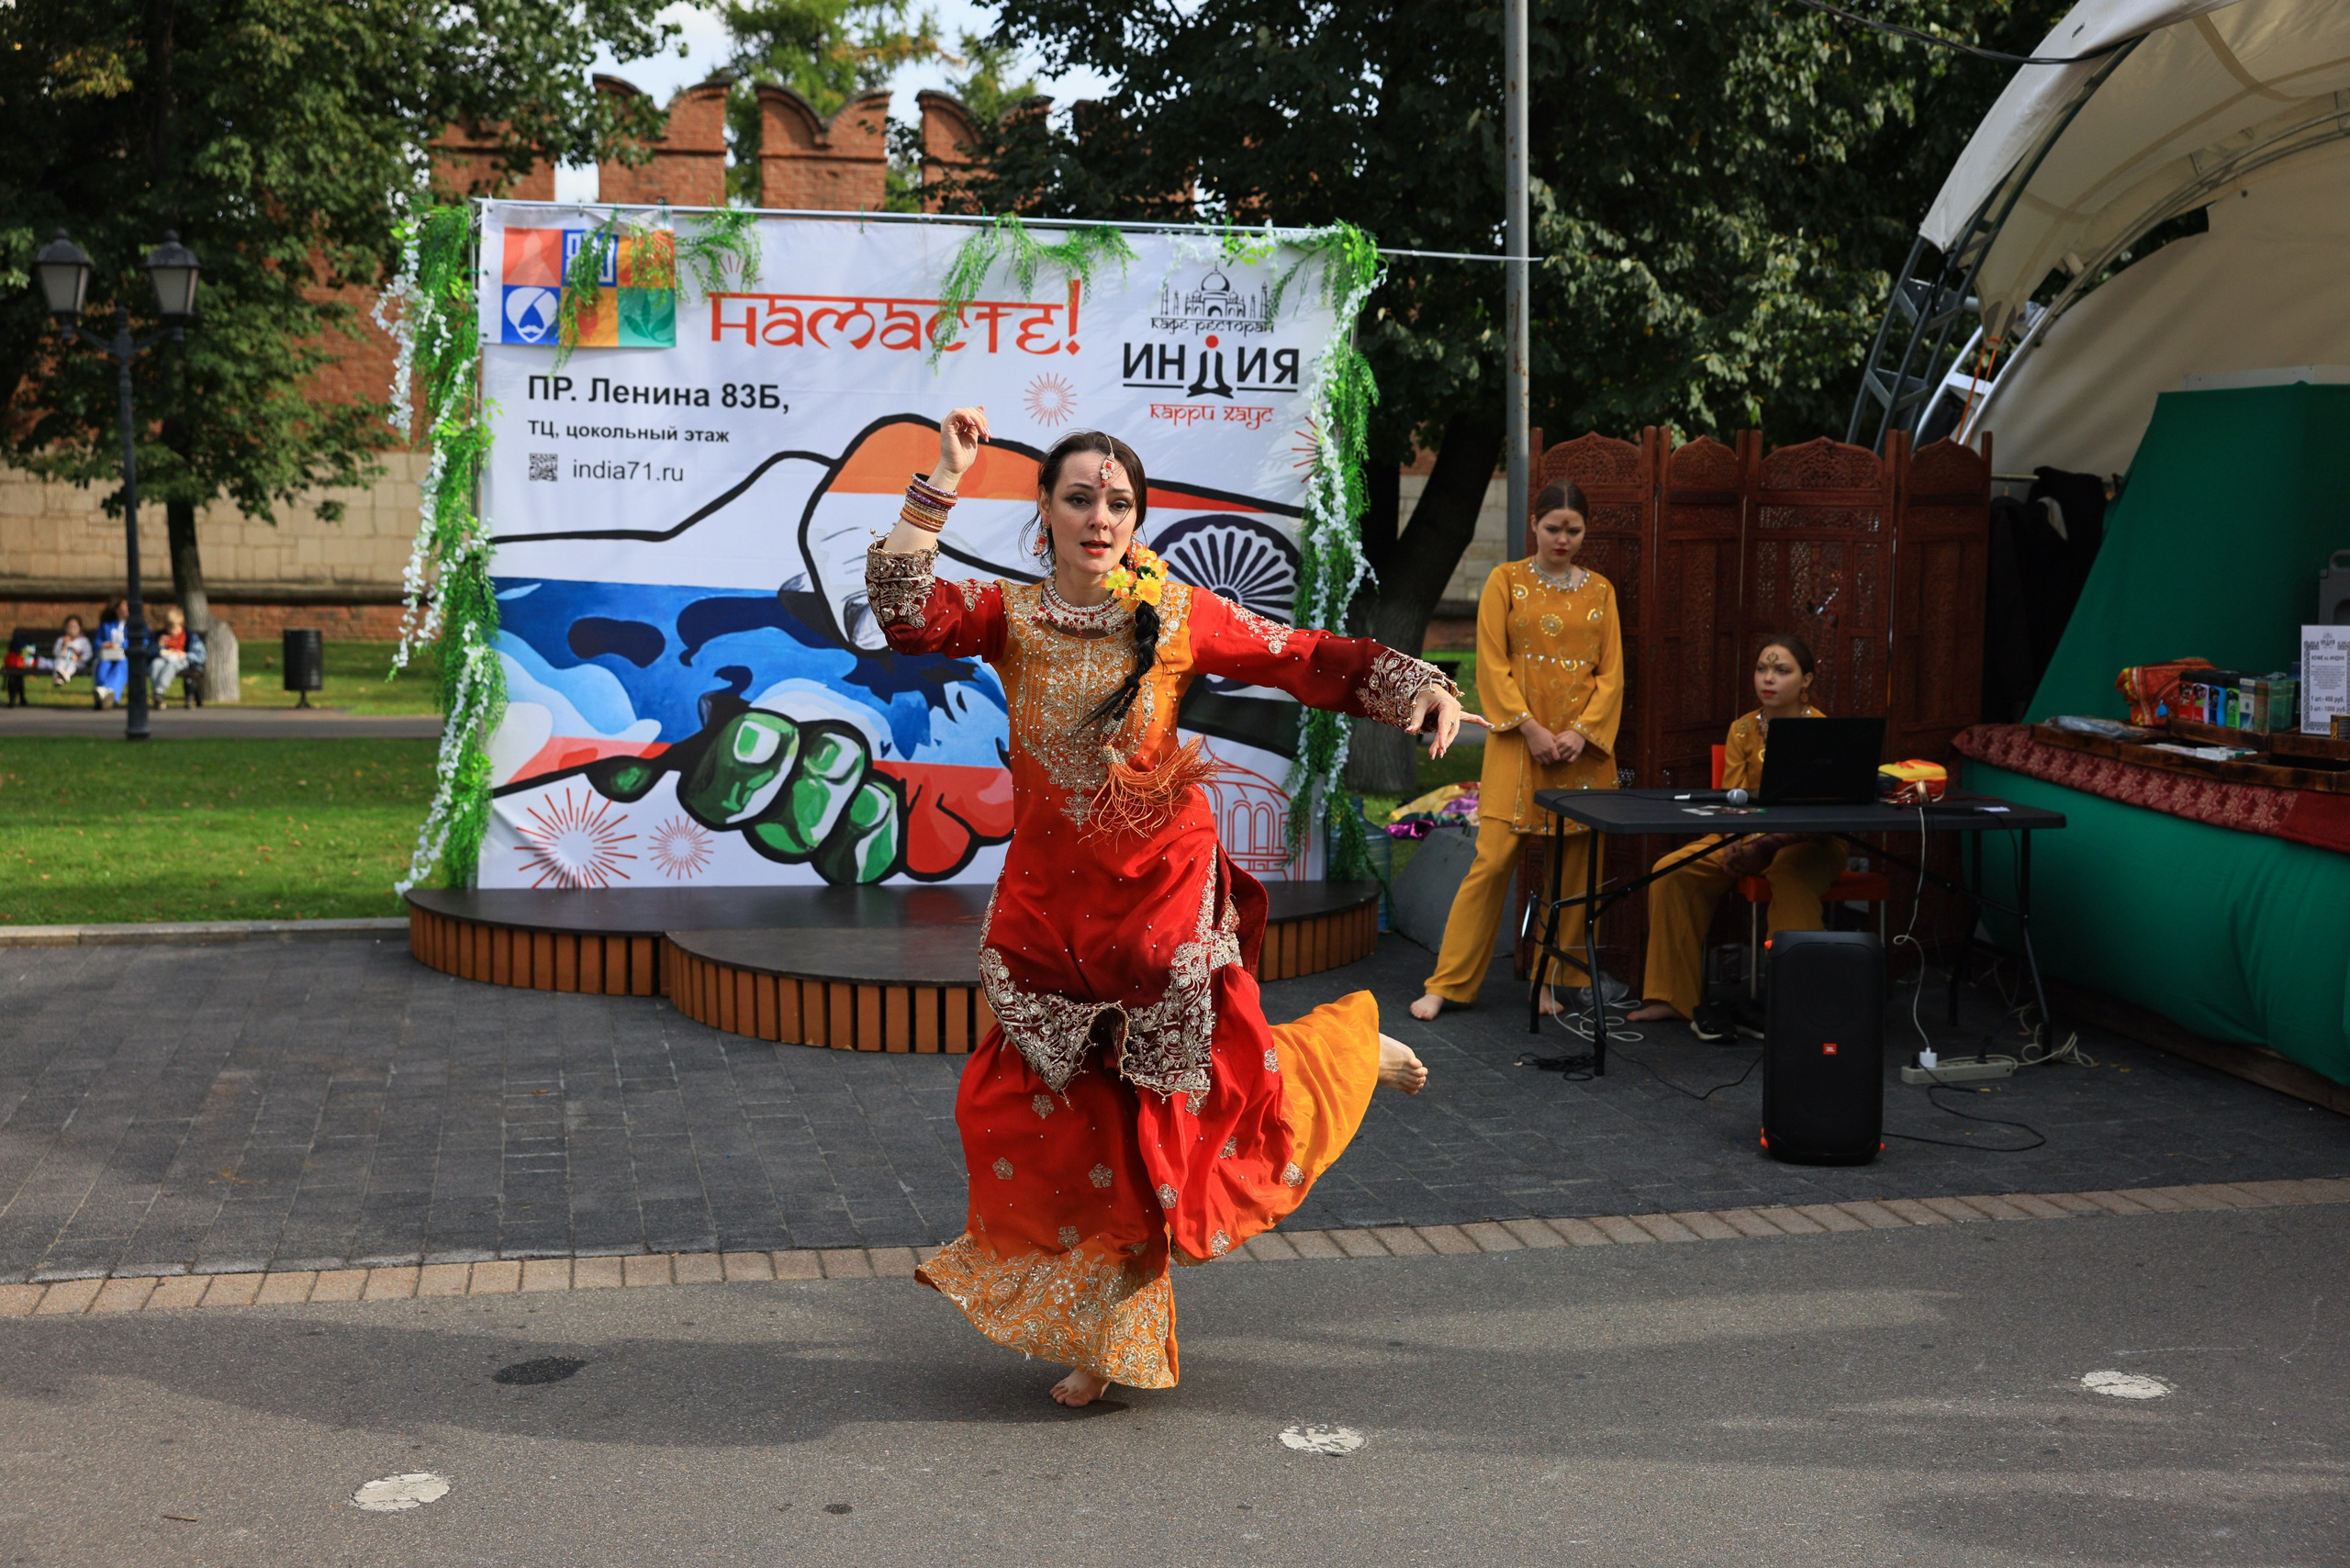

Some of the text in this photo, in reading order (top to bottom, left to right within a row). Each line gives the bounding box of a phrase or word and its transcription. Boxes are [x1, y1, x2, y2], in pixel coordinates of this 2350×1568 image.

[528, 375, 789, 414] ПР. Ленина 83Б,
[528, 420, 730, 442] ТЦ, цокольный этаж
[573, 459, 684, 482] india71.ru
